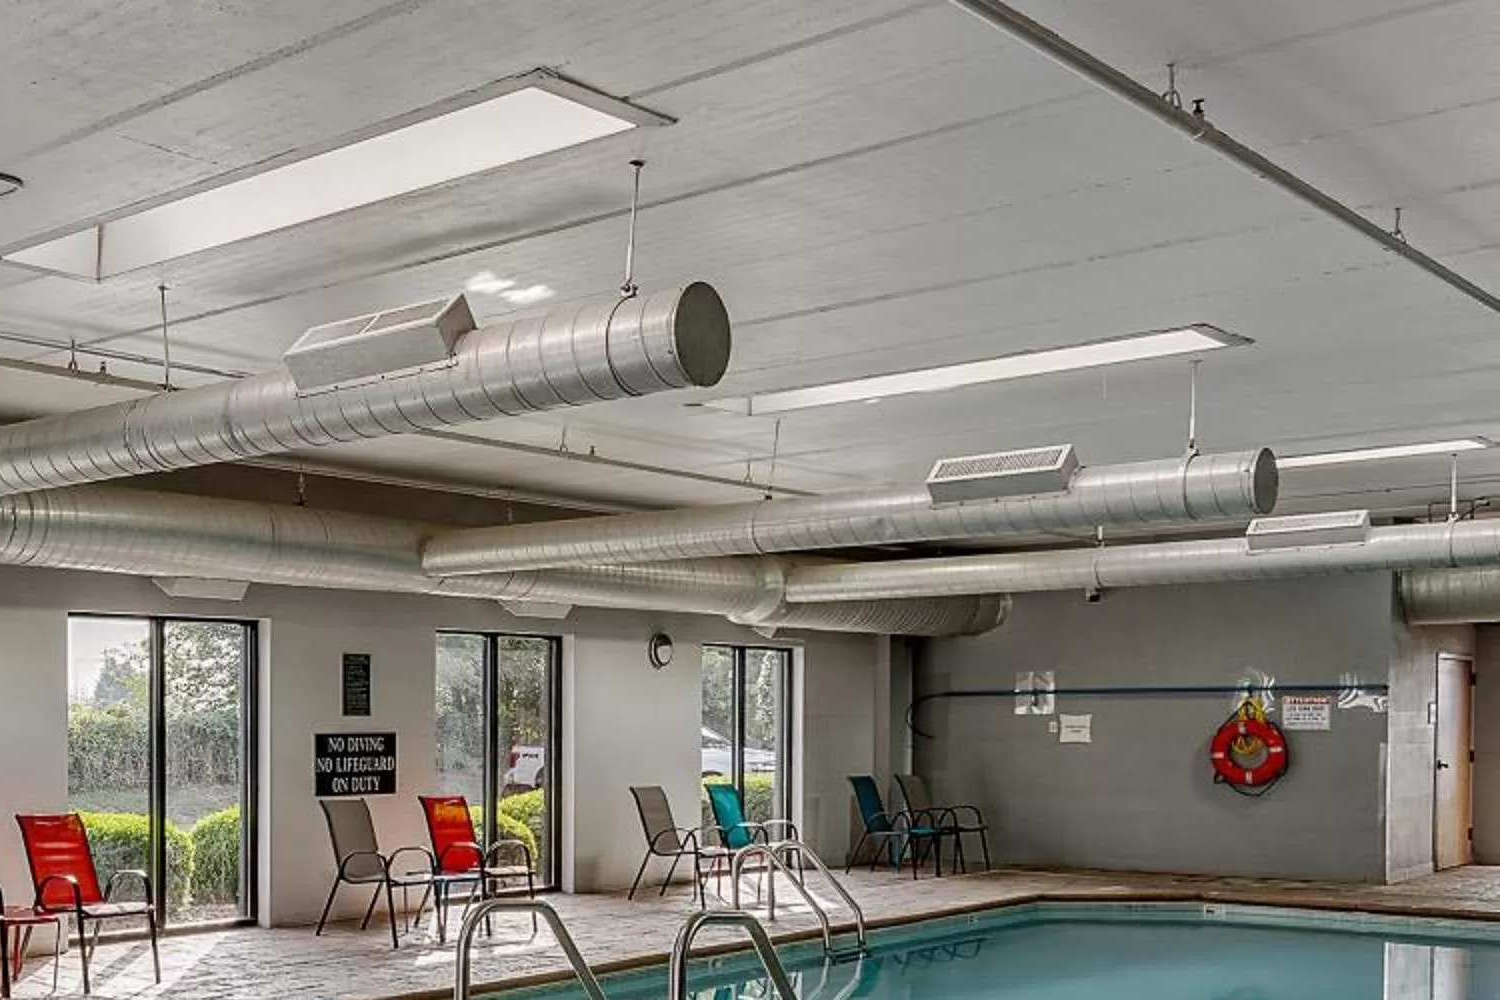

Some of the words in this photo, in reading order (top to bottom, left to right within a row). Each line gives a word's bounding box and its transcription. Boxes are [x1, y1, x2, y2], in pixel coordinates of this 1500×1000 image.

[327, 736, 345, 753] NO
[347, 735, 385, 753] DIVING
[315, 757, 333, 773] NO
[335, 755, 395, 773] LIFEGUARD
[331, 776, 349, 793] ON
[351, 775, 380, 793] DUTY
